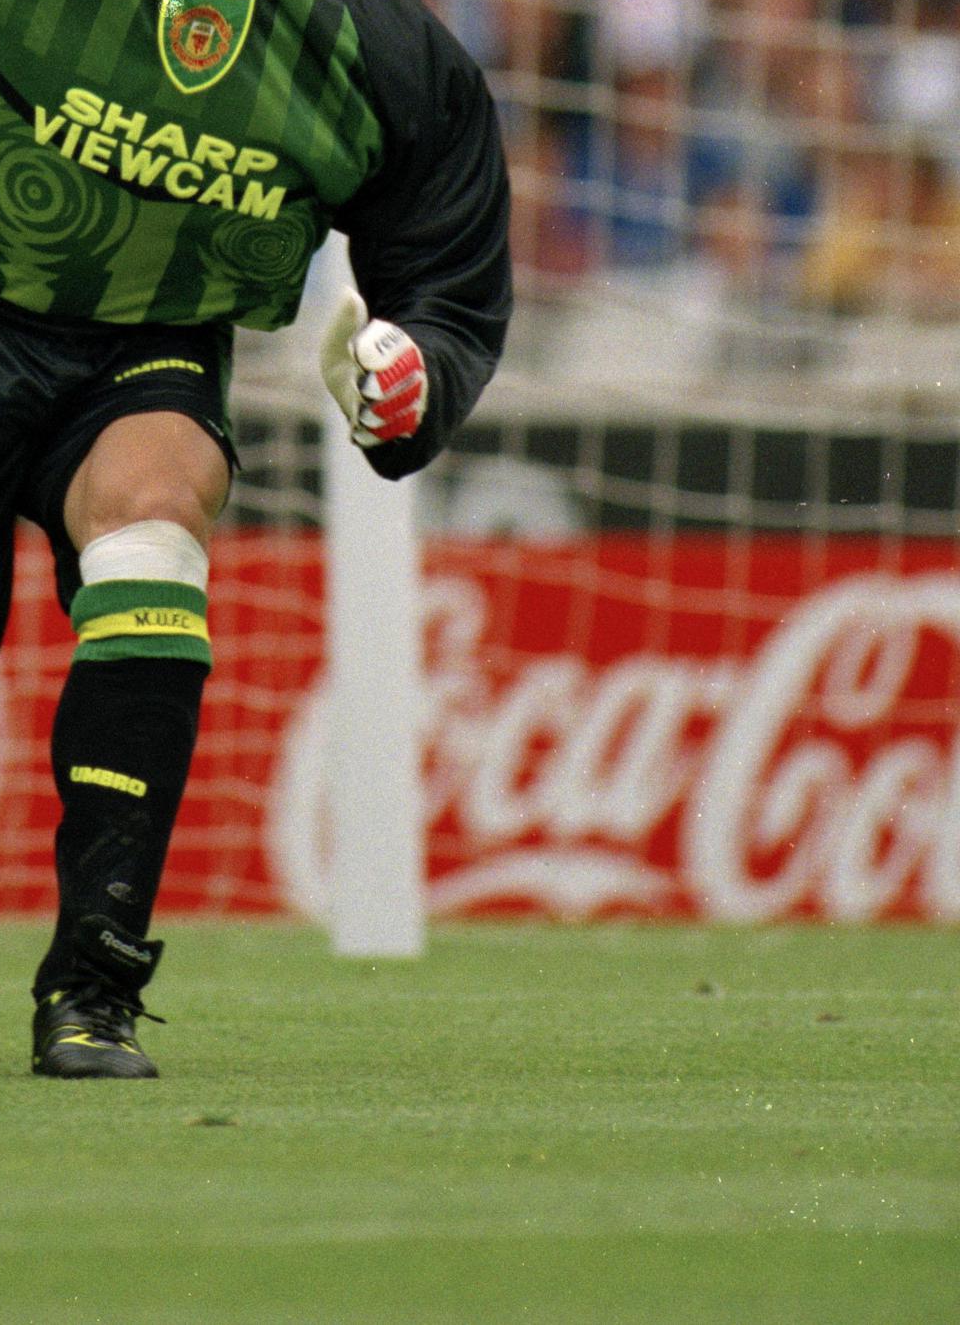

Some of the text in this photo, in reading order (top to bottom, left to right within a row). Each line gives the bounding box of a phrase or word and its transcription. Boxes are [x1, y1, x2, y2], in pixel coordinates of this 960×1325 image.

[34, 105, 287, 220] VIEWCAM
[59, 87, 279, 176] SHARP
[70, 765, 147, 797] UMBRO
